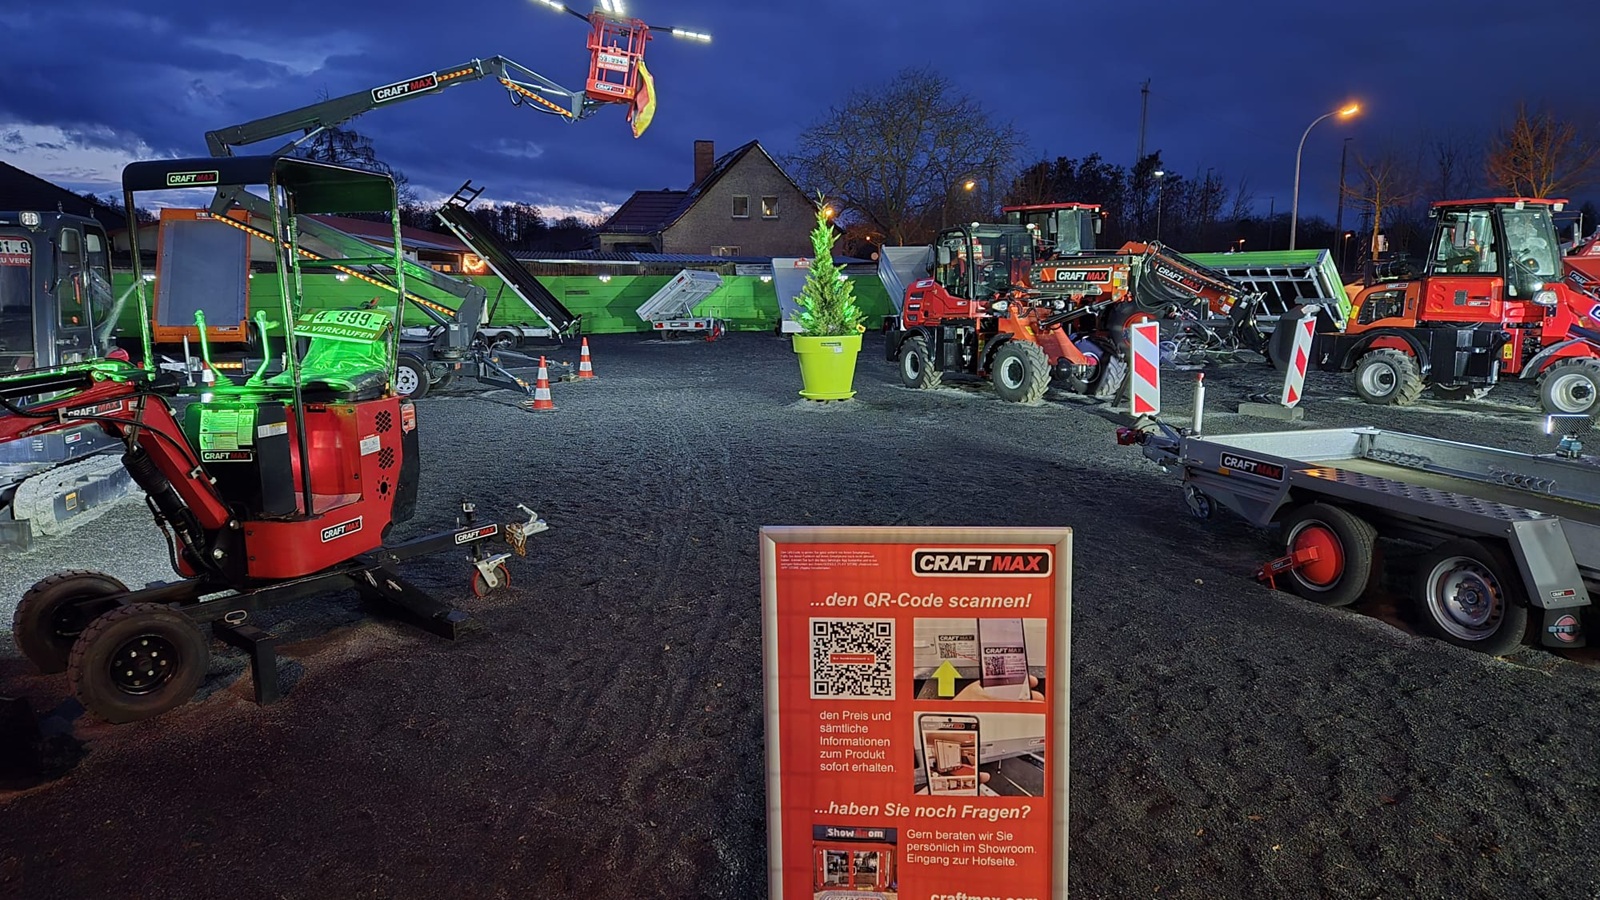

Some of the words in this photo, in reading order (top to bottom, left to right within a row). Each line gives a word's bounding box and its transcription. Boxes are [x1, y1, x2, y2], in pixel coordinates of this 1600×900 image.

[0, 241, 31, 254] 1.9
[311, 325, 376, 339] VERKAUFEN
[810, 592, 858, 608] ...den
[863, 592, 944, 609] QR-Code
[949, 593, 1032, 608] scannen!
[819, 711, 840, 721] den
[842, 711, 869, 721] Preis
[871, 711, 891, 721] und
[819, 723, 869, 734] sämtliche
[820, 736, 891, 747] Informationen
[819, 751, 842, 760] zum
[845, 749, 886, 760] Produkt
[820, 761, 850, 772] sofort
[852, 762, 897, 773] erhalten.
[814, 801, 879, 816] ...haben
[884, 802, 911, 817] Sie
[915, 803, 957, 818] noch
[961, 805, 1032, 822] Fragen?
[906, 829, 933, 841] Gern
[935, 830, 976, 841] beraten
[978, 830, 994, 841] wir
[996, 830, 1014, 842] Sie
[906, 842, 960, 855] persönlich
[963, 843, 975, 853] im
[978, 843, 1037, 854] Showroom.
[906, 854, 949, 867] Eingang
[952, 857, 970, 866] zur
[972, 855, 1018, 867] Hofseite.
